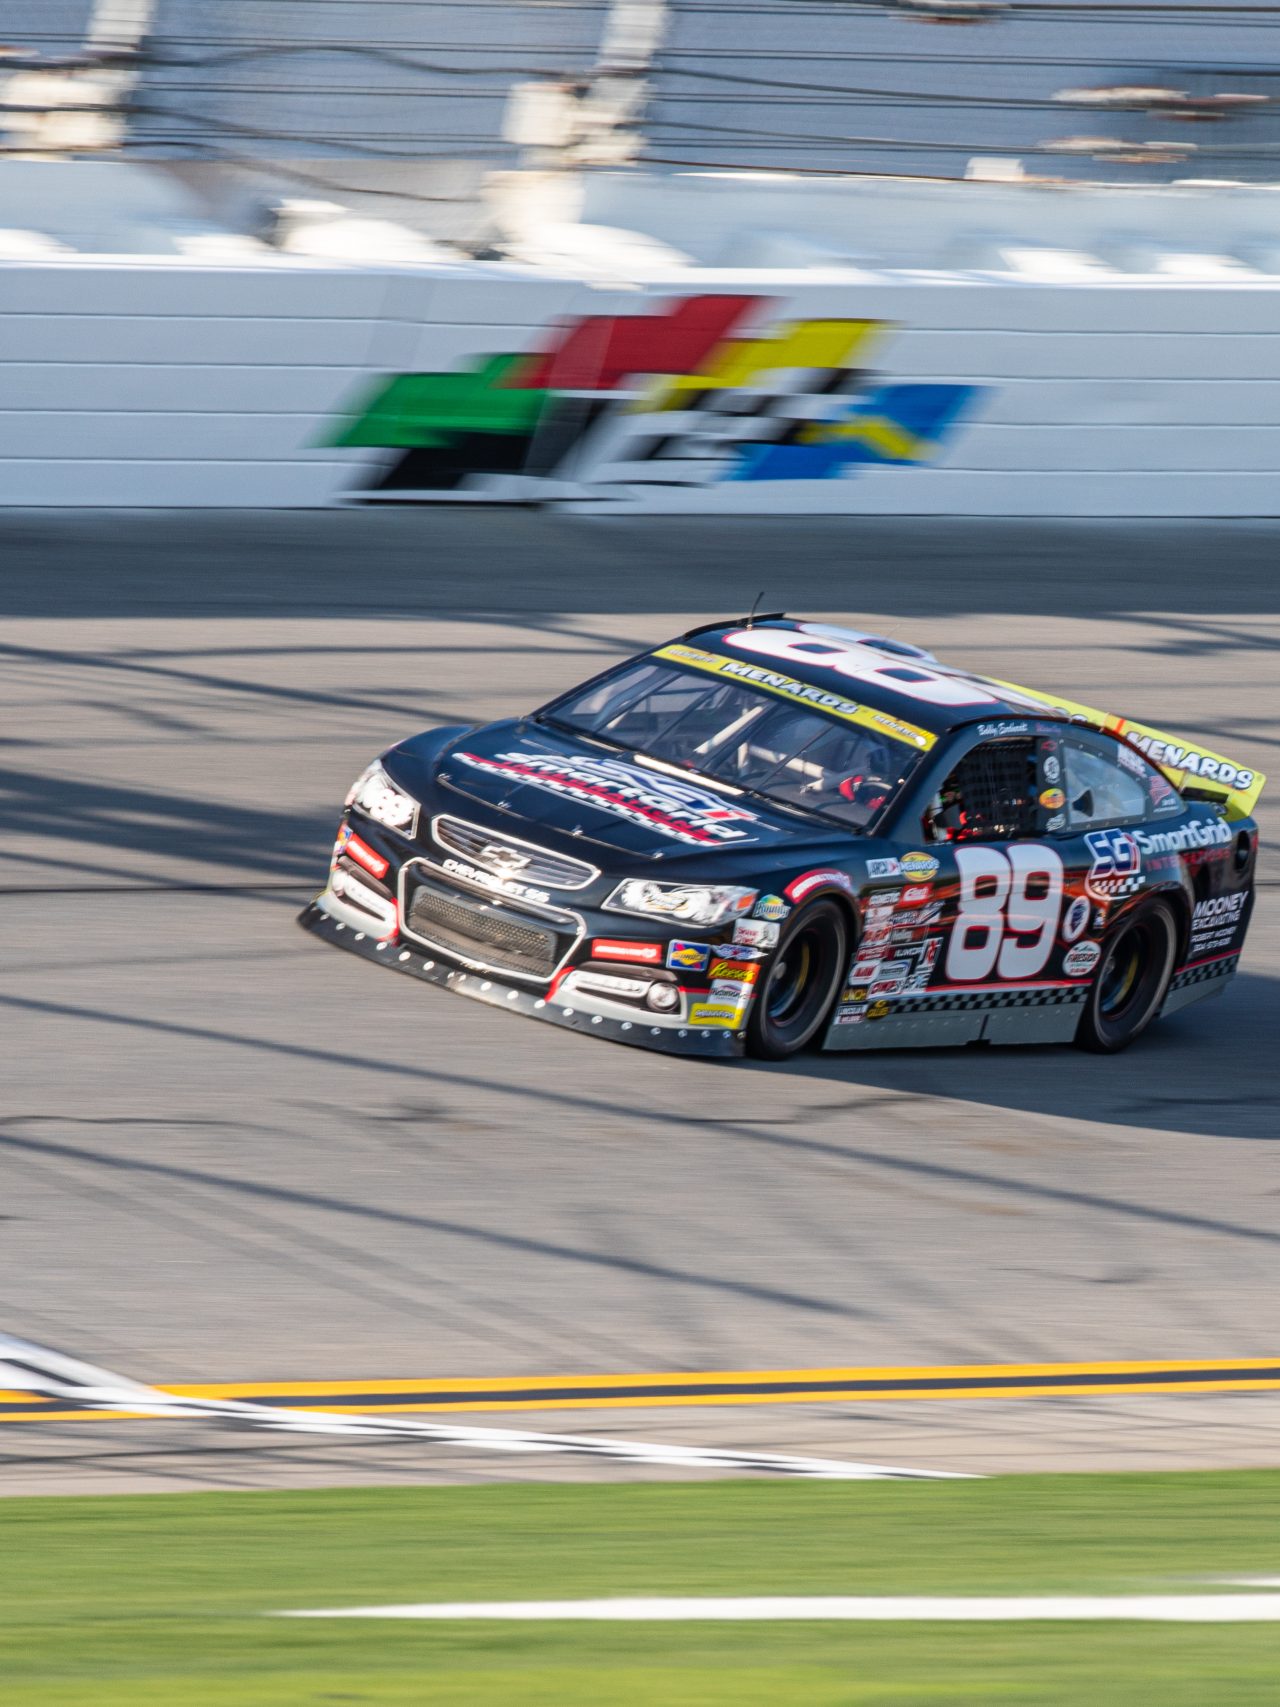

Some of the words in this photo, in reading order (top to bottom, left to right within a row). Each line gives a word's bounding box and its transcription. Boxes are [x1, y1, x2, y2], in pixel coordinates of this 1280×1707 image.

[720, 661, 858, 715] MENARDS
[1126, 731, 1254, 789] MENARDS
[1131, 816, 1233, 855] SmartGrid
[945, 844, 1064, 981] 89
[1192, 890, 1249, 919] MOONEY
